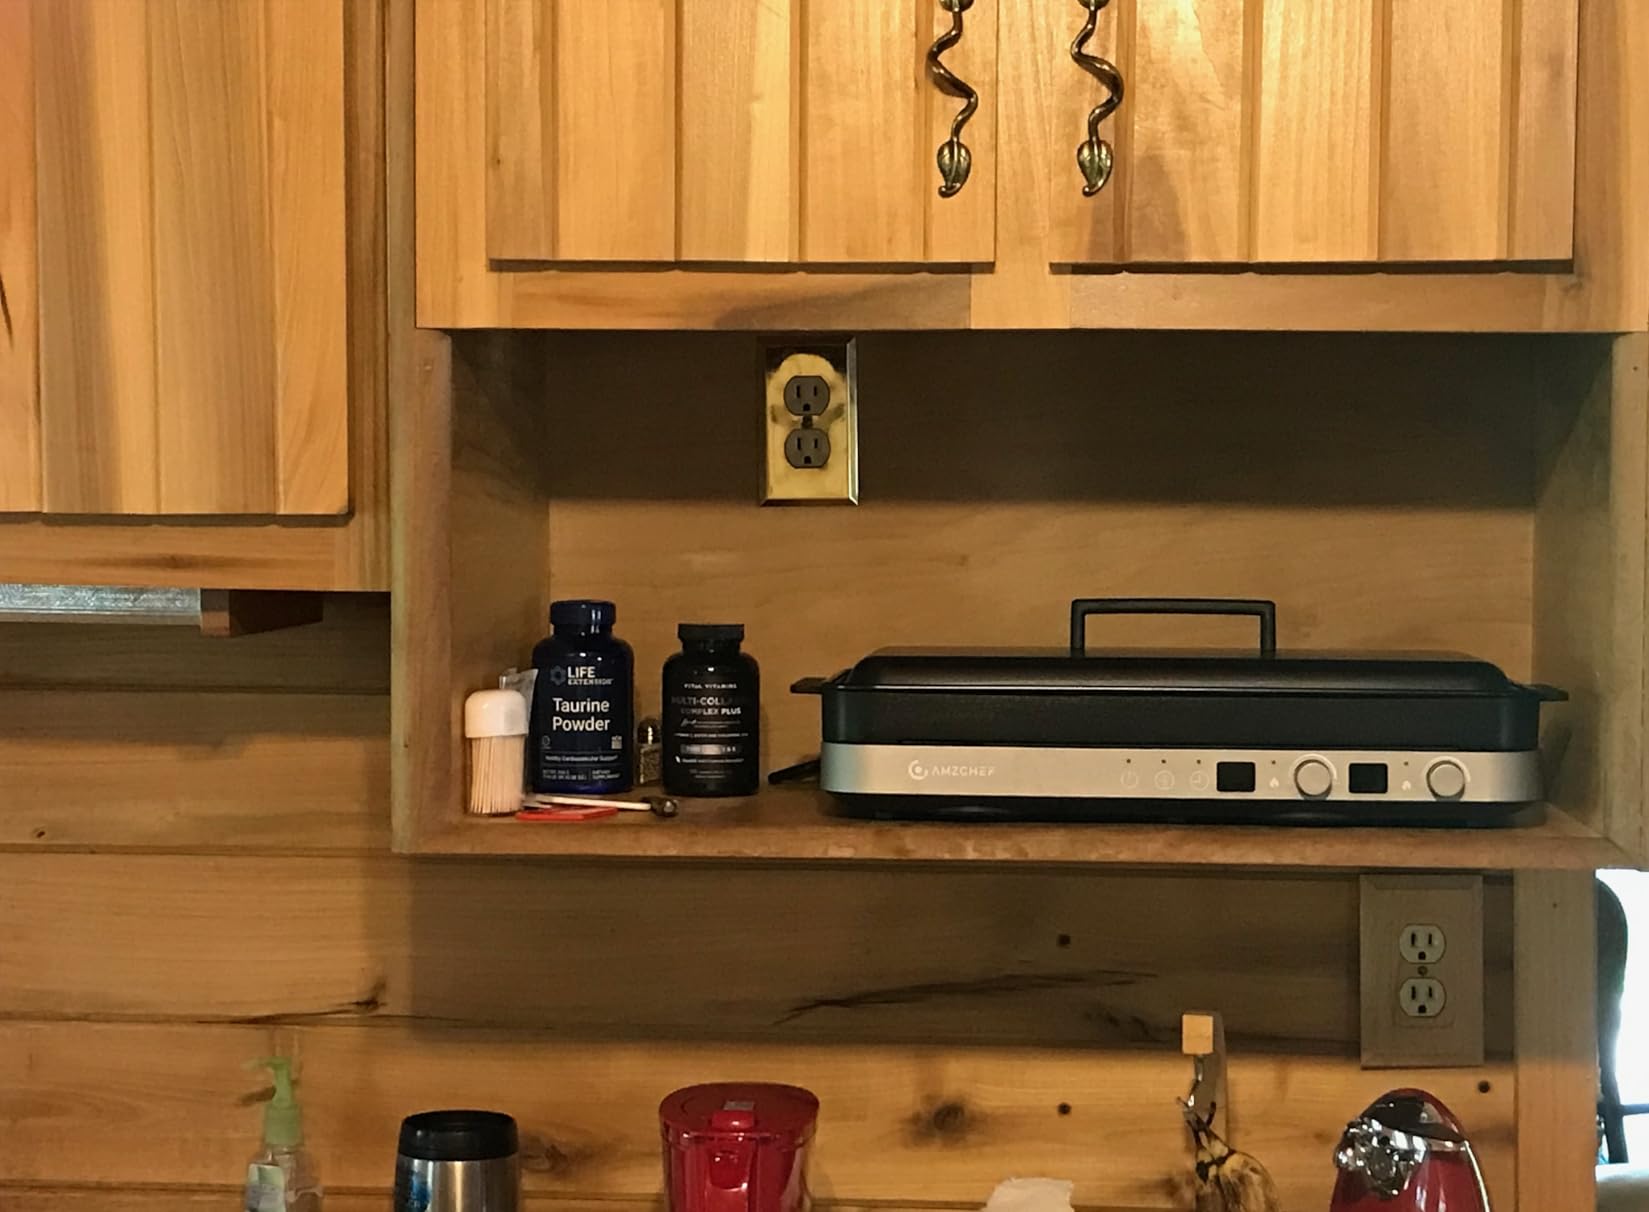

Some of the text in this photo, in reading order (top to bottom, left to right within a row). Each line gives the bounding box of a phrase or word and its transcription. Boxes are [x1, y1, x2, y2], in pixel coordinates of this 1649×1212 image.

[567, 666, 596, 679] LIFE
[552, 697, 610, 713] Taurine
[720, 707, 742, 715] PLUS
[552, 716, 611, 732] Powder
